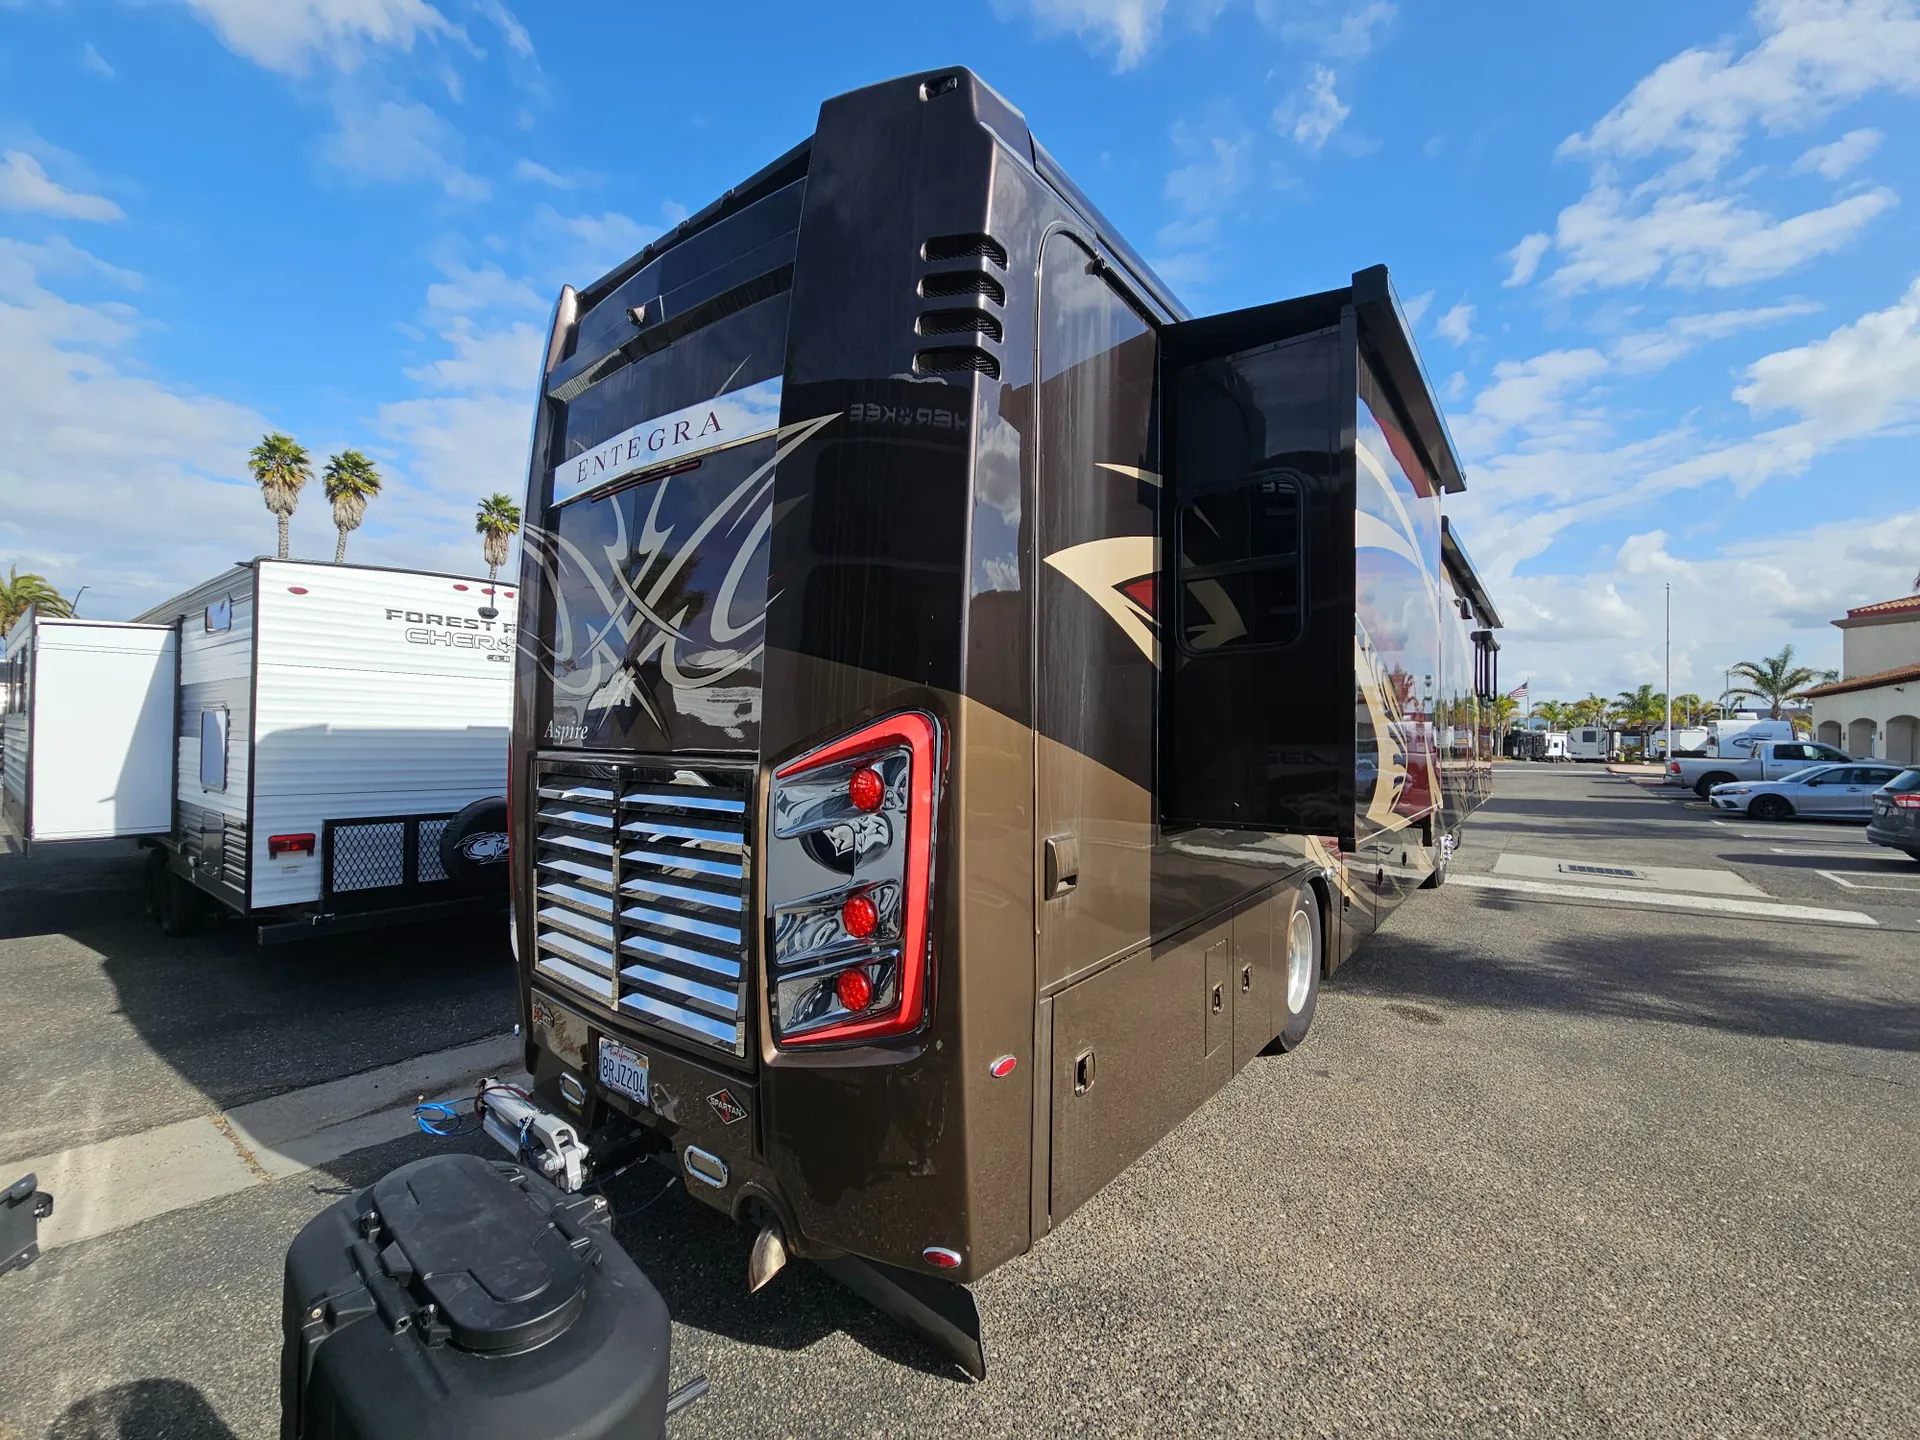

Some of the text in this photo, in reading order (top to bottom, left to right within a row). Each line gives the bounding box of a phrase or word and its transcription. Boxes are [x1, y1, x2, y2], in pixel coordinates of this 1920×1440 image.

[576, 411, 723, 483] ENTEGRA
[385, 608, 496, 631] FOREST
[543, 720, 588, 745] Aspire
[602, 1056, 645, 1096] 8RJZ204
[709, 1097, 742, 1117] SPARTAN
